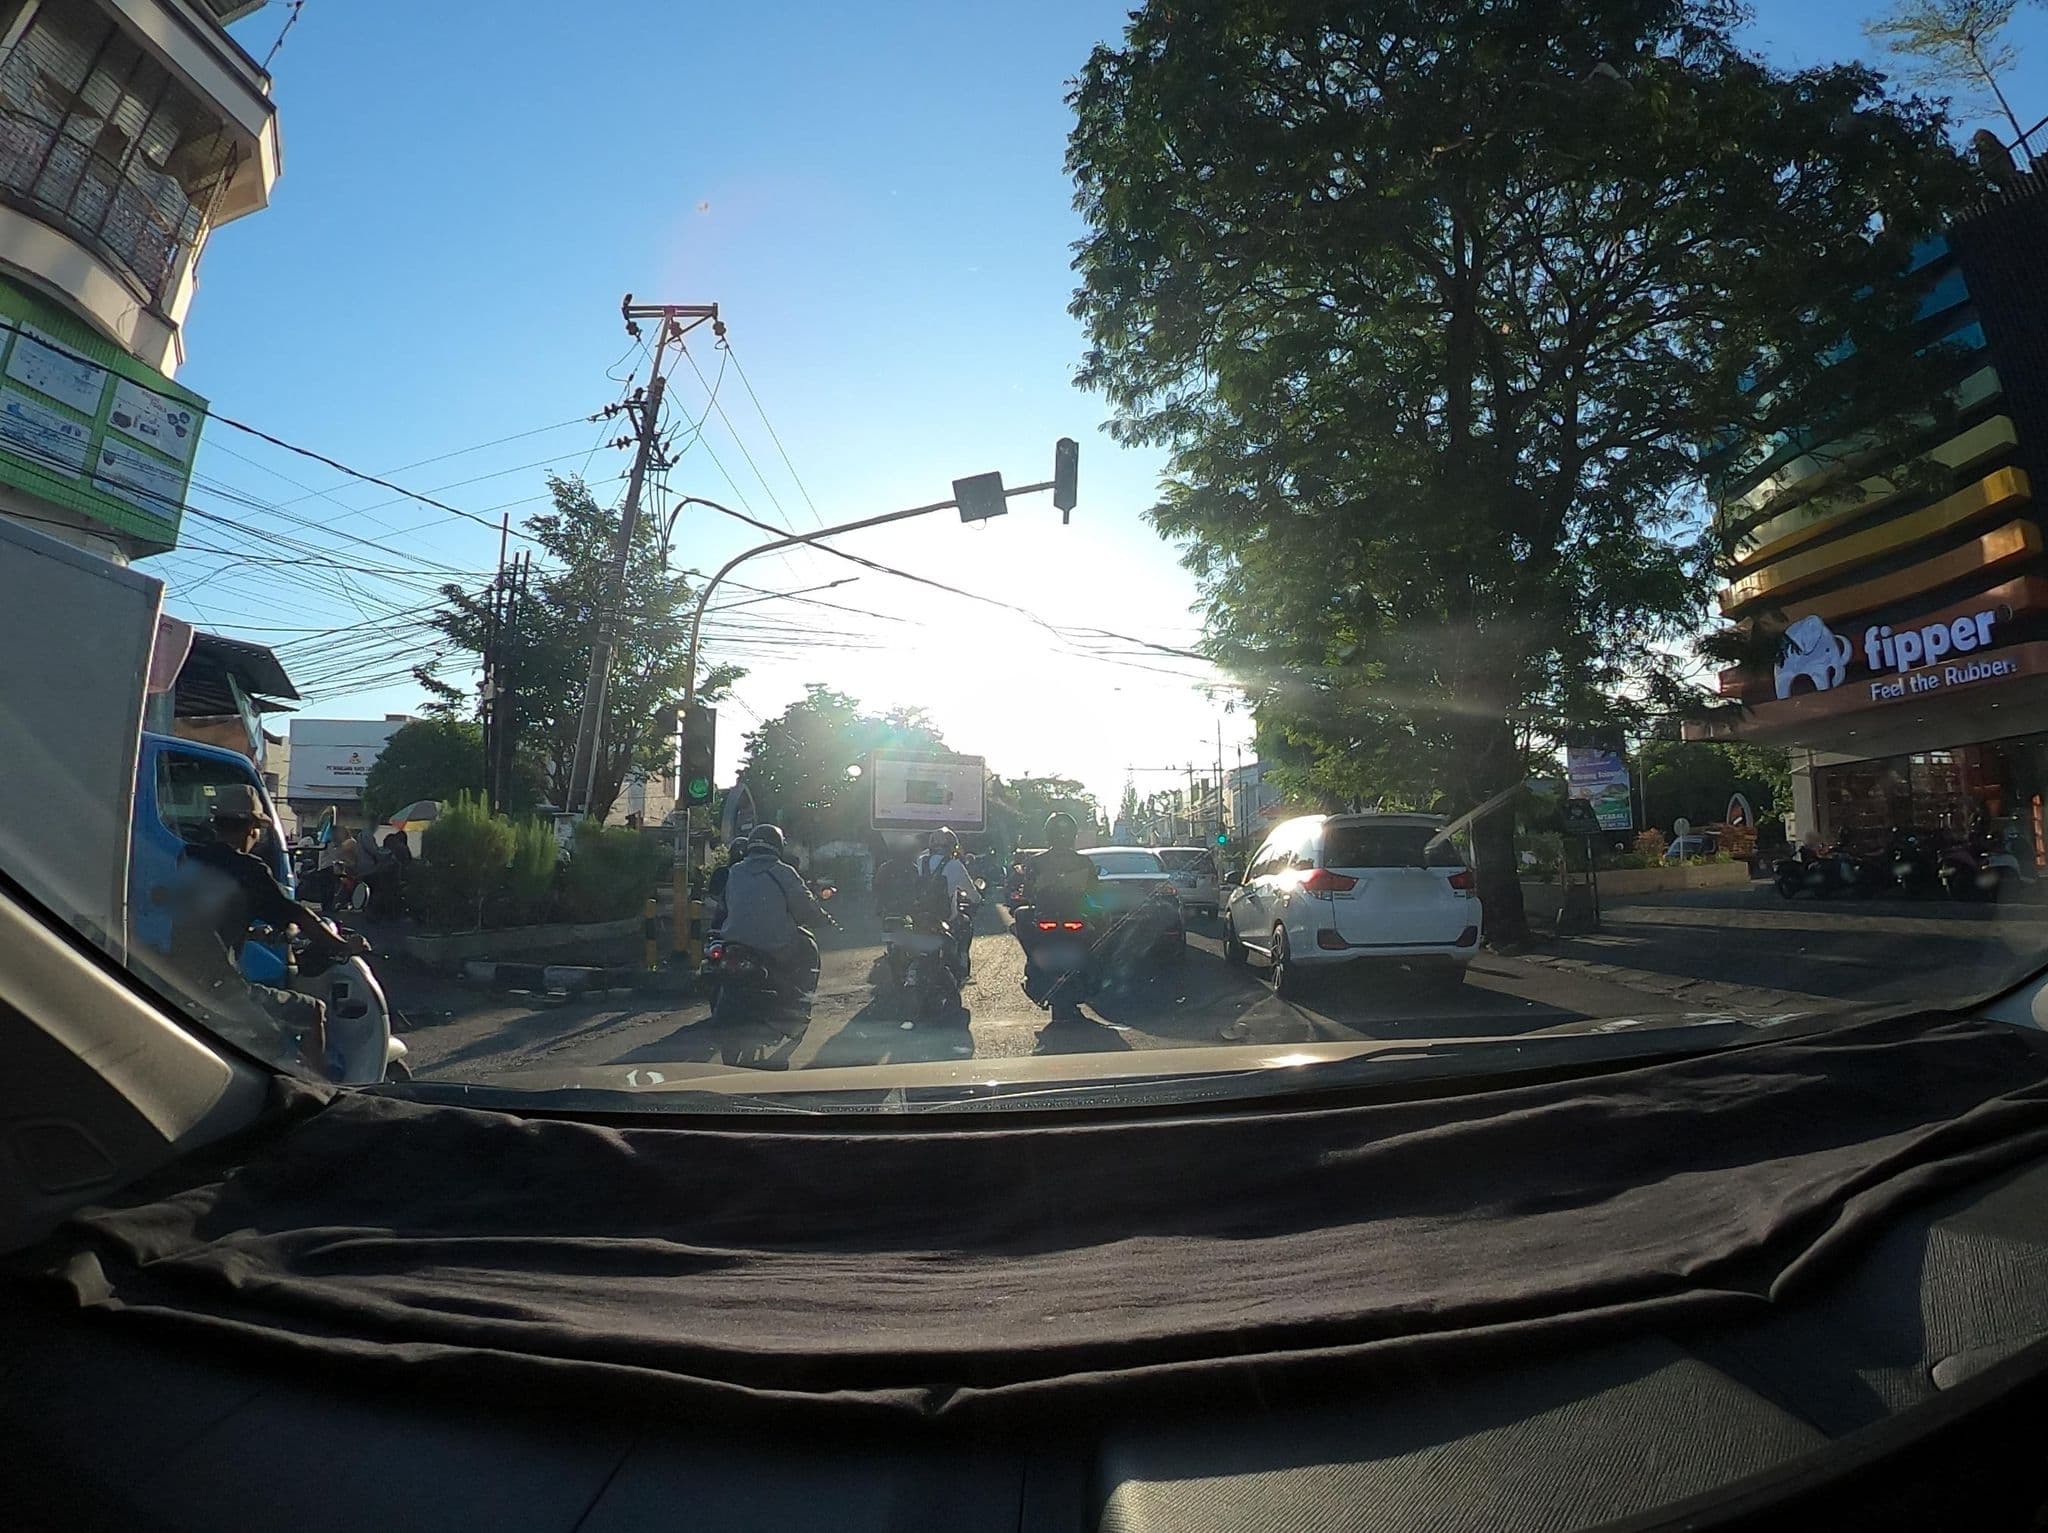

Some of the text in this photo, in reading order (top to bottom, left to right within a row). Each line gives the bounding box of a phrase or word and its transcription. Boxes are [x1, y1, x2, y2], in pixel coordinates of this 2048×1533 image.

[1864, 610, 1996, 673] fipper
[1870, 677, 1905, 701] Feel
[1909, 672, 1939, 693] the
